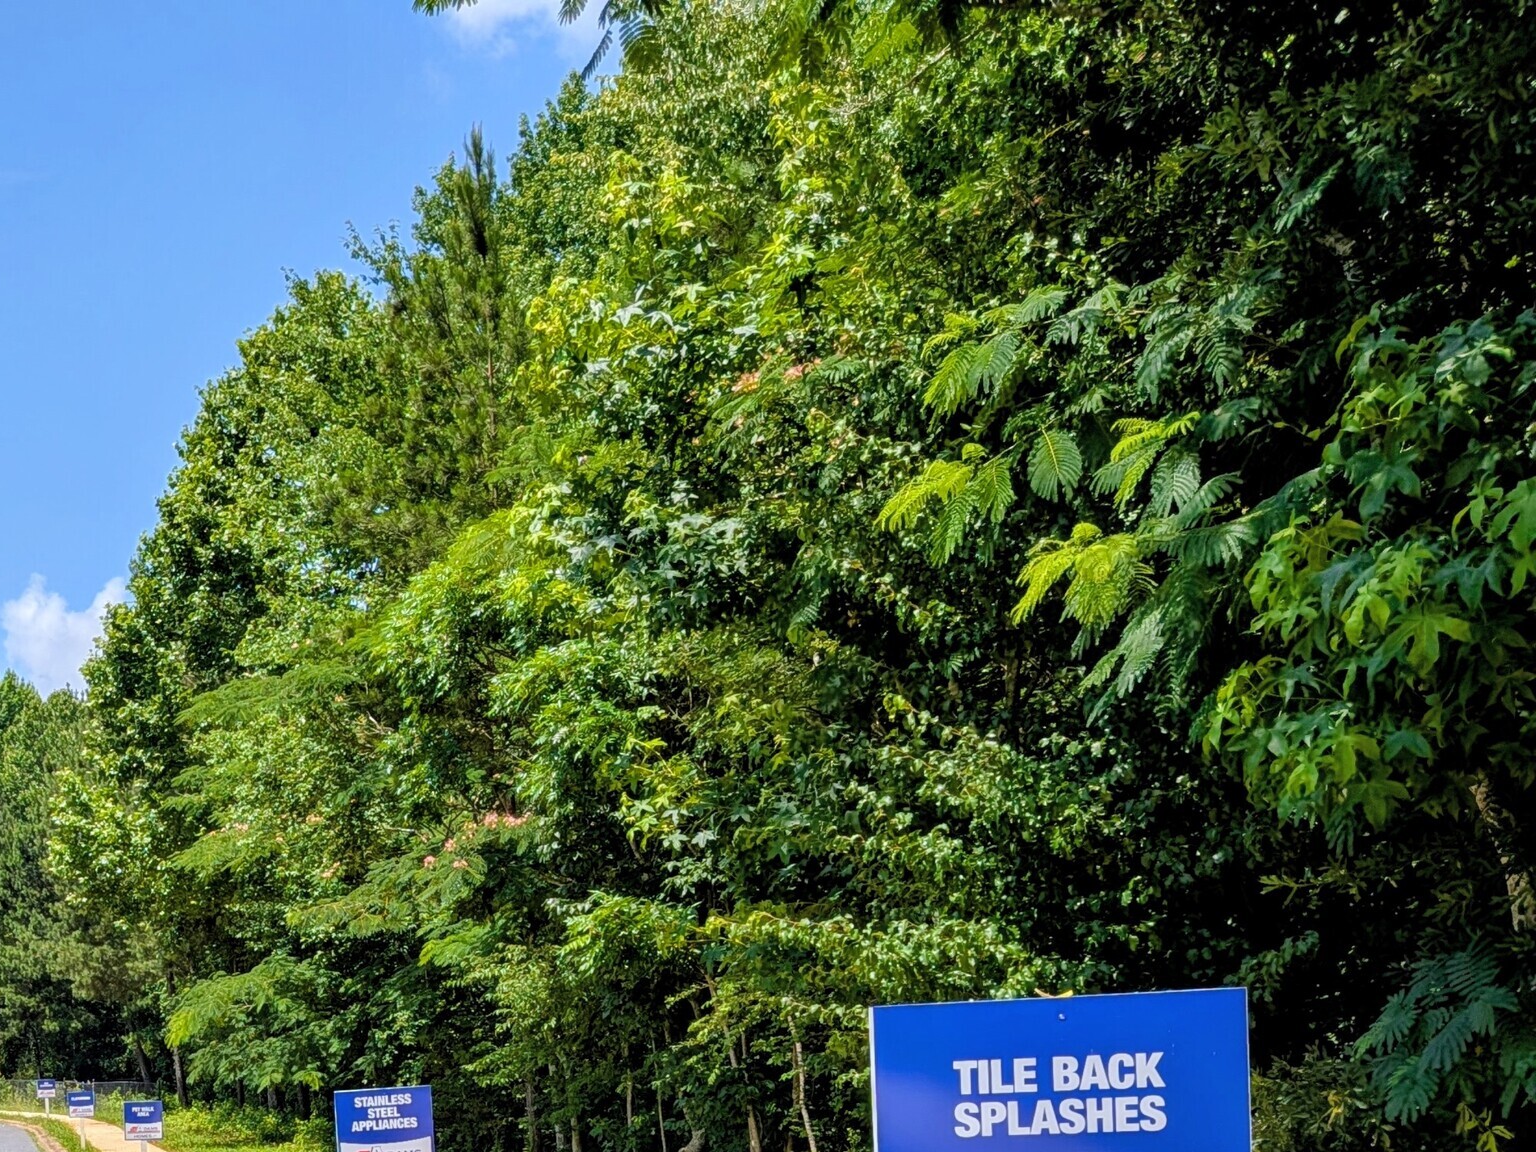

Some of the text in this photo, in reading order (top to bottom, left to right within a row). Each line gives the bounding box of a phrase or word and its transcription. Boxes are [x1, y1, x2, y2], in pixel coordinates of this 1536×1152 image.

[953, 1052, 1166, 1096] TILE BACK
[354, 1093, 412, 1108] STAINLESS
[367, 1106, 400, 1119] STEEL
[954, 1095, 1167, 1138] SPLASHES
[352, 1117, 418, 1132] APPLIANCES
